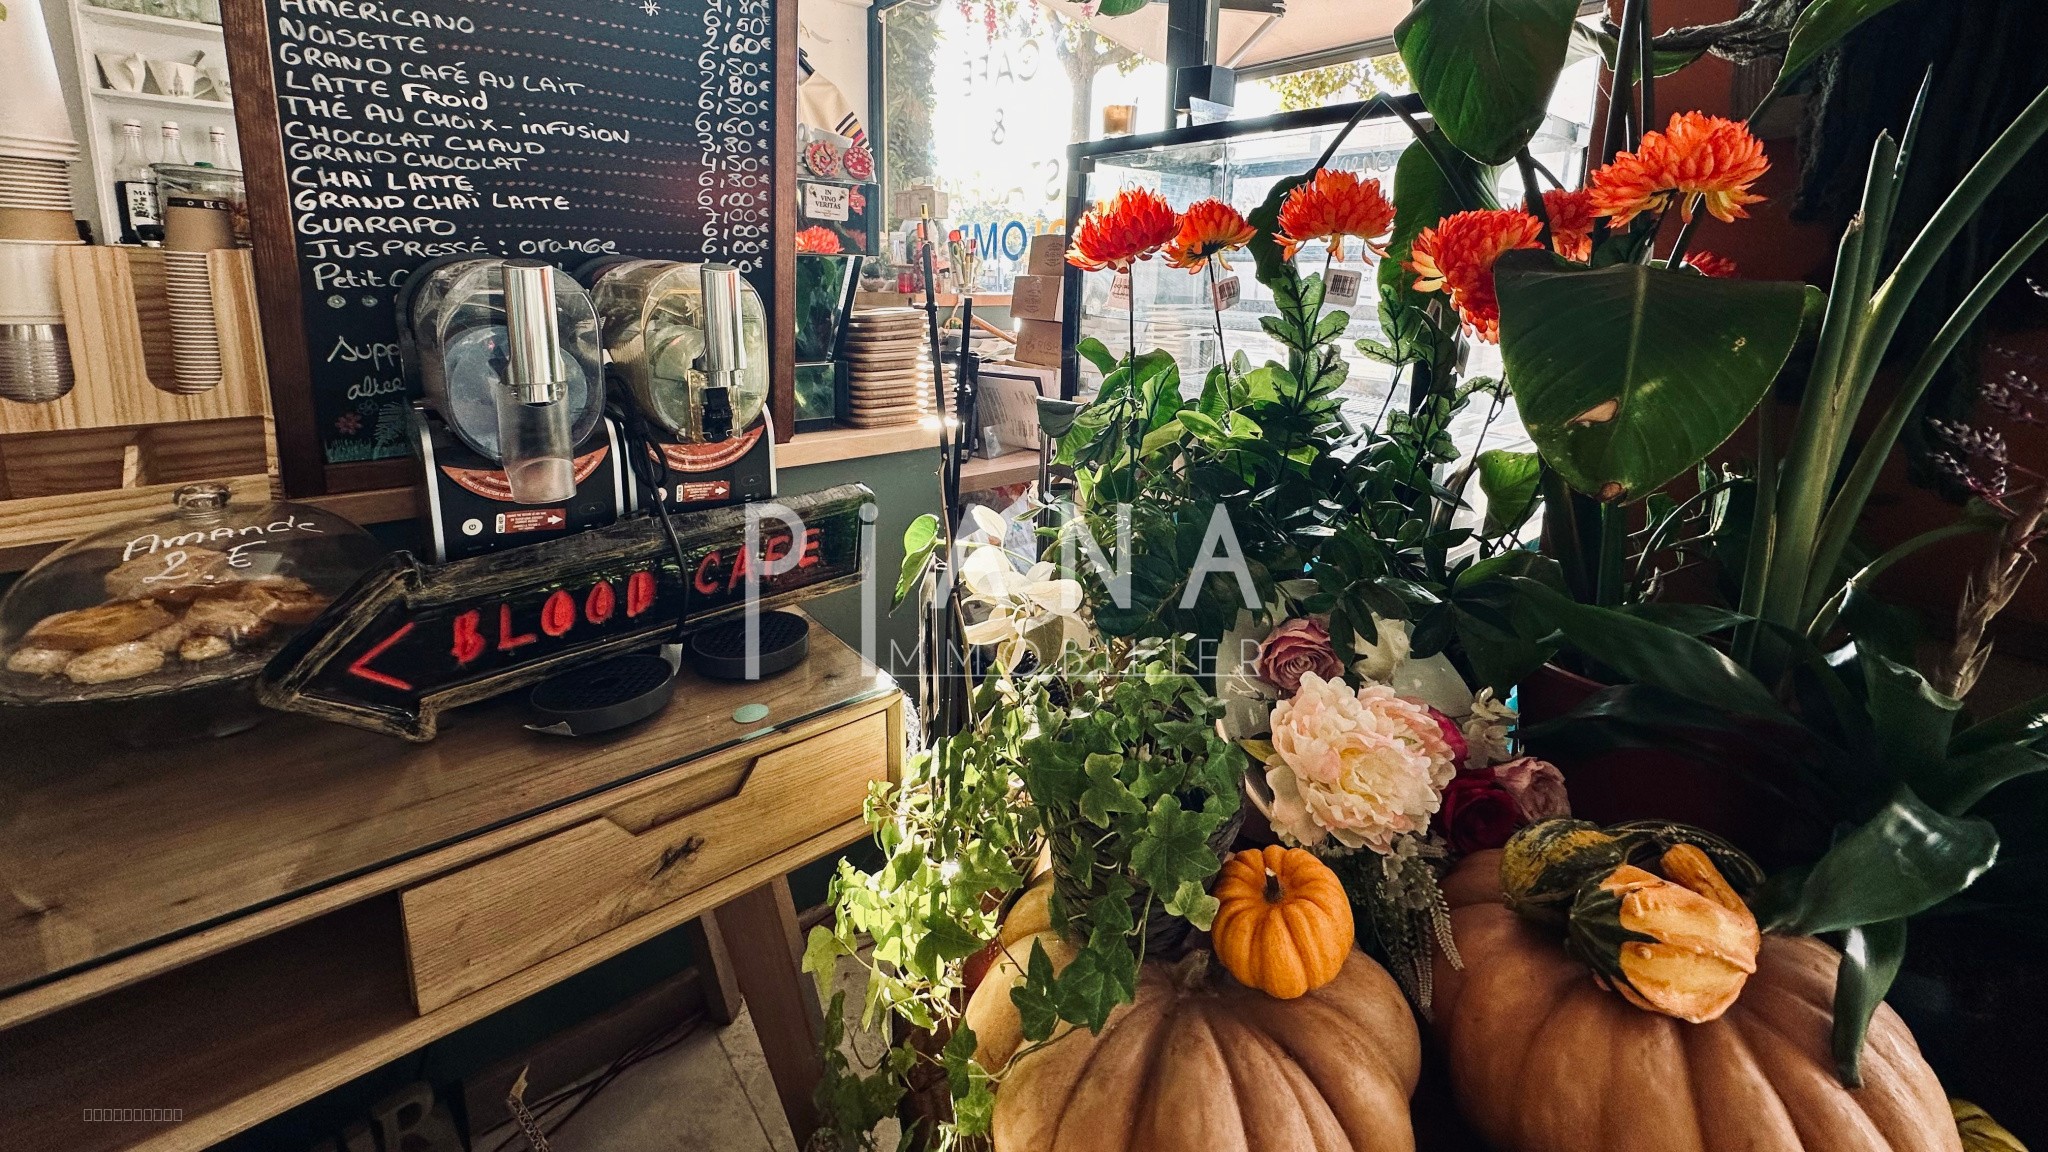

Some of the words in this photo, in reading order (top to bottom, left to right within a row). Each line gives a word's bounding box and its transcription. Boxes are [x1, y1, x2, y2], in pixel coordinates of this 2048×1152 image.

[279, 17, 428, 54] NOISETTE
[700, 71, 771, 97] 2,80€
[701, 26, 771, 56] 2,60€
[698, 50, 771, 76] 6,50€
[285, 70, 390, 98] LATTE
[695, 111, 770, 136] 6,60€
[401, 61, 470, 85] CAFÉ
[479, 71, 515, 89] AU
[523, 75, 585, 96] LAIT
[698, 91, 769, 115] 6,50€
[278, 93, 352, 120] THÉ
[365, 103, 404, 124] AU
[413, 110, 498, 132] CHOIX
[697, 132, 769, 154] 3,80€
[284, 121, 435, 149] CHOCOLAT
[445, 136, 545, 154] CHAUD
[701, 152, 770, 172] 4,50€
[290, 143, 397, 164] GRAND
[403, 152, 528, 171] CHOCOLAT
[698, 170, 769, 188] 6,80€
[134, 189, 159, 197] MON
[291, 165, 373, 188] CHAÏ
[387, 172, 475, 192] LATTE
[697, 188, 768, 207] 6,00€
[821, 195, 836, 203] VINO
[294, 188, 405, 211] GRAND
[413, 192, 482, 211] CHAÏ
[492, 193, 570, 210] LATTE
[698, 206, 769, 224] 7,00€
[815, 201, 841, 209] VERITAS
[298, 212, 457, 236] GUARAPO
[702, 221, 769, 240] 6,00€
[304, 238, 373, 259] JUS
[383, 236, 489, 258] PRESSÉ
[701, 237, 770, 256] 6,00€
[313, 262, 386, 291] Petit
[327, 335, 400, 371] Supp
[451, 570, 658, 666] BLOOD
